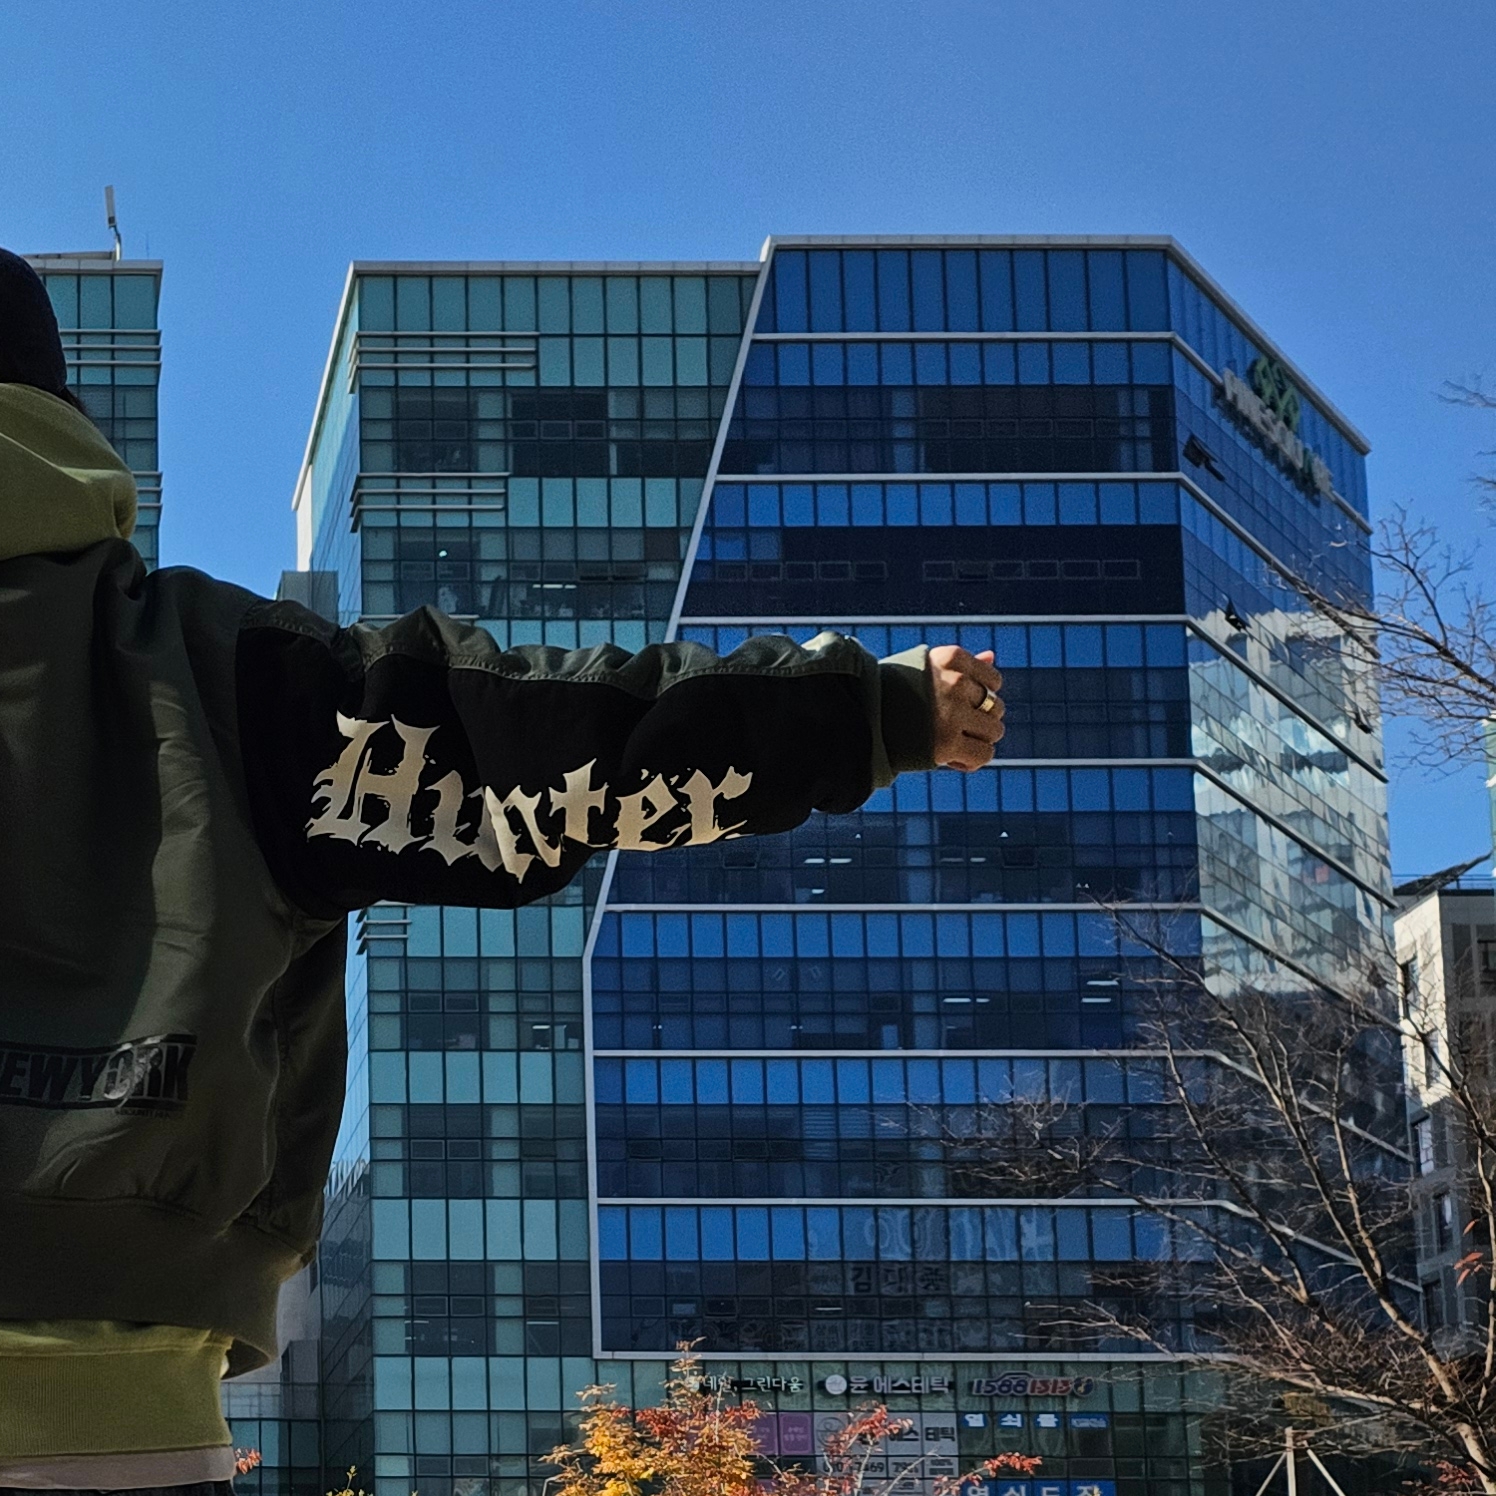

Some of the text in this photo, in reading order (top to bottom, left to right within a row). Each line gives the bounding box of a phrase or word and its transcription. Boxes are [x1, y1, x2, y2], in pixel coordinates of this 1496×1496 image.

[307, 711, 755, 884] Hunter
[741, 1374, 803, 1393] 그린다움
[873, 1375, 949, 1394] 에스테틱
